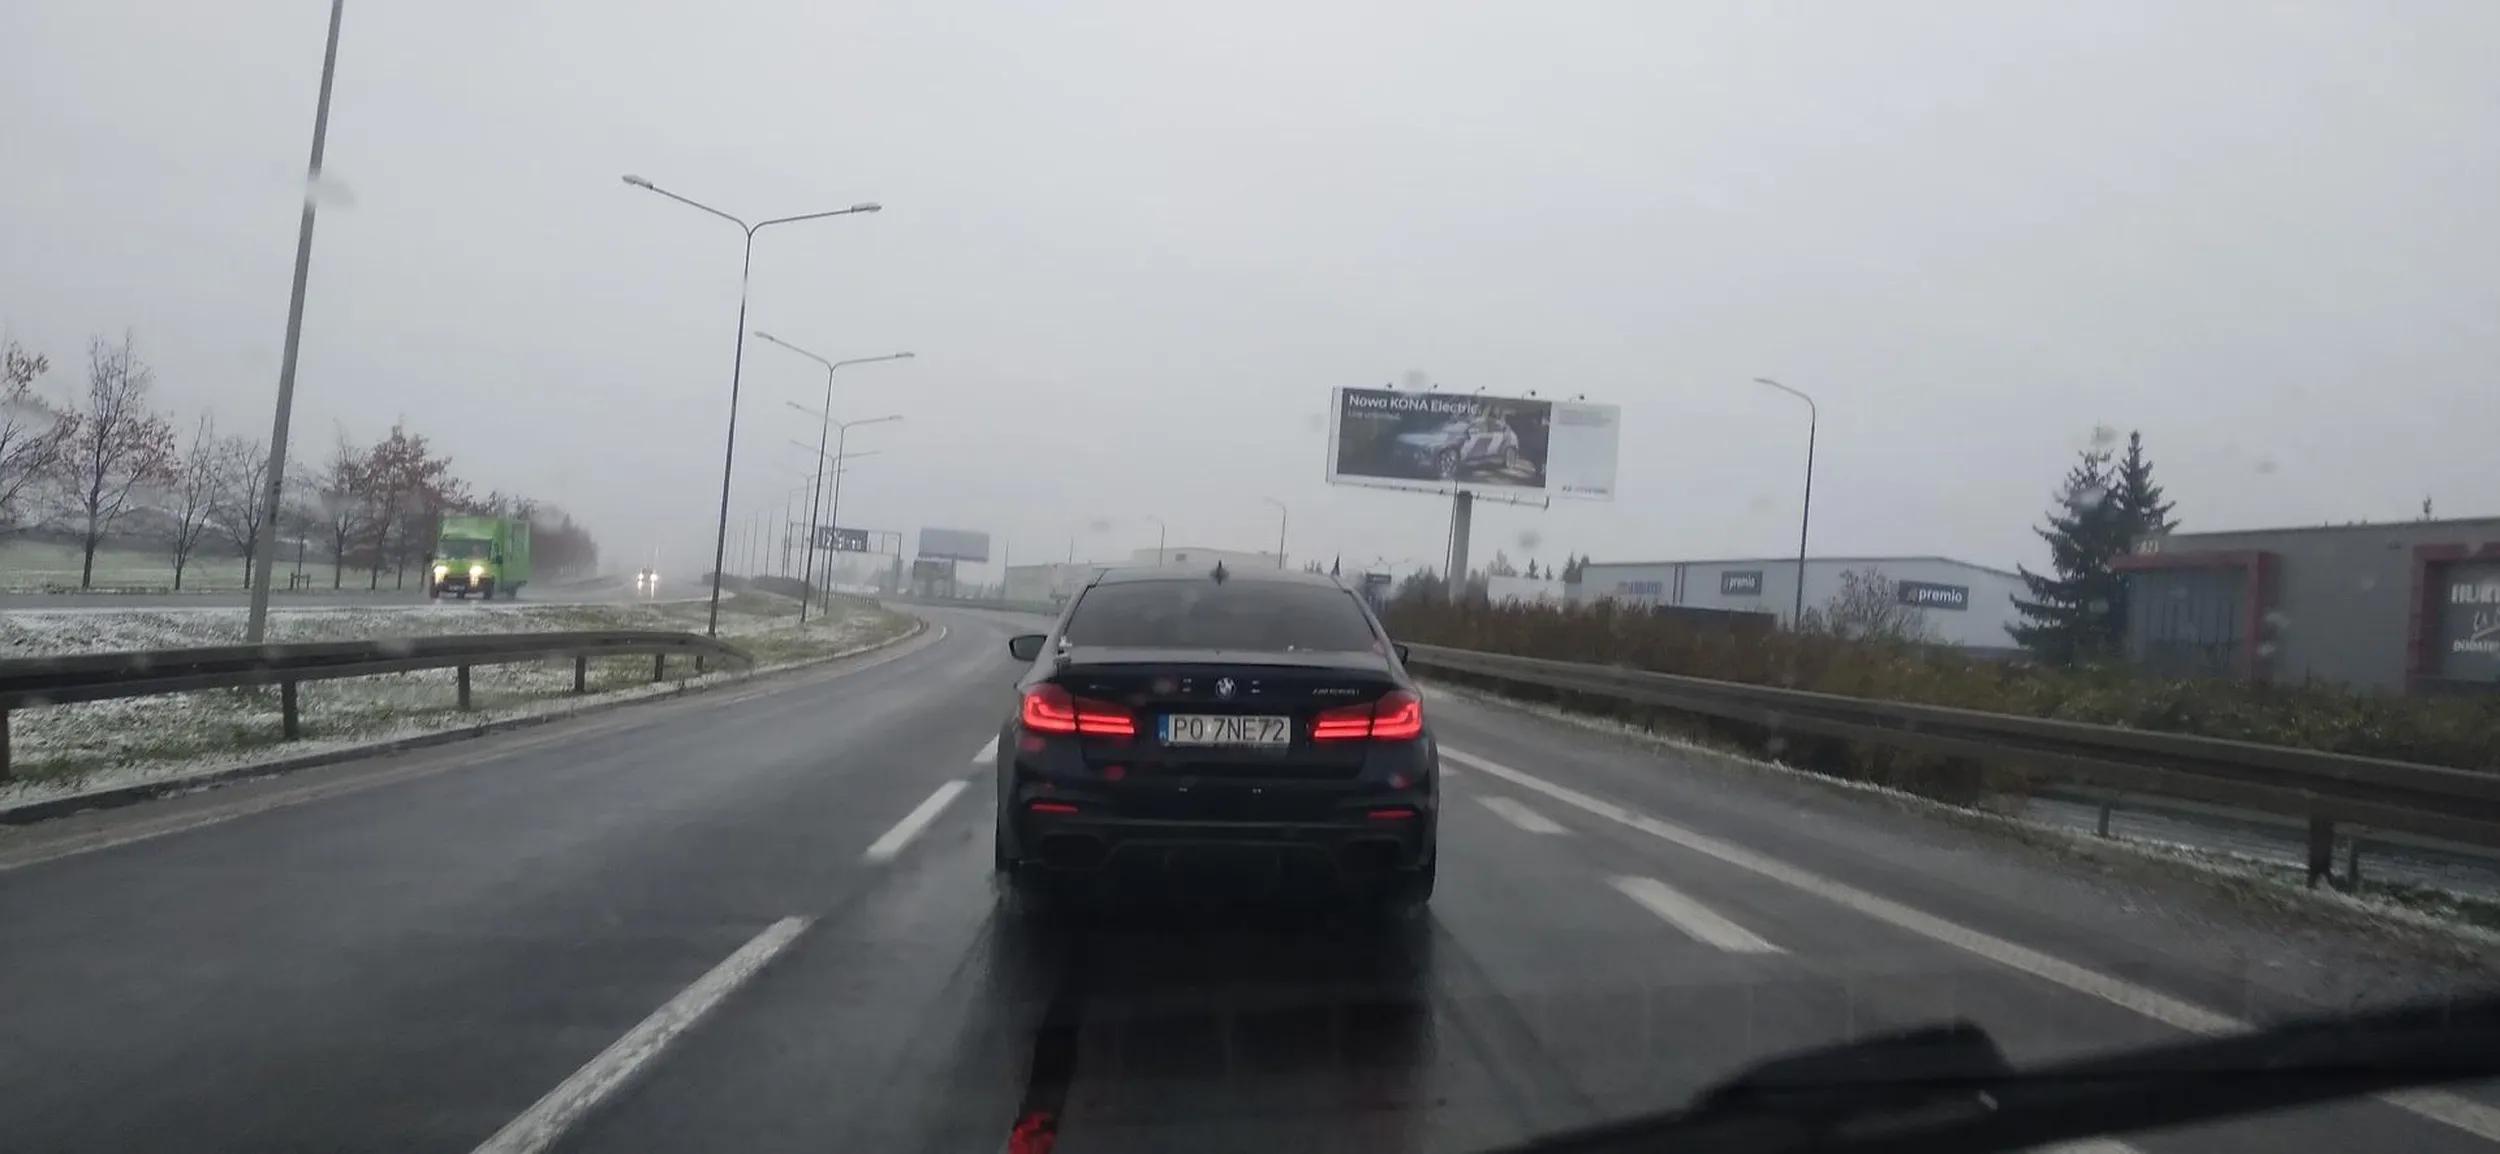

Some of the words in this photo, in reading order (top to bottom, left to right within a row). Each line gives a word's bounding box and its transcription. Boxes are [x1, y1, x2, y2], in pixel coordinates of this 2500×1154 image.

[1349, 394, 1388, 408] Nowa
[1390, 396, 1429, 412] KONA
[1918, 586, 1963, 605] premio
[1174, 717, 1204, 742] PO
[1213, 717, 1286, 742] 7NE72
